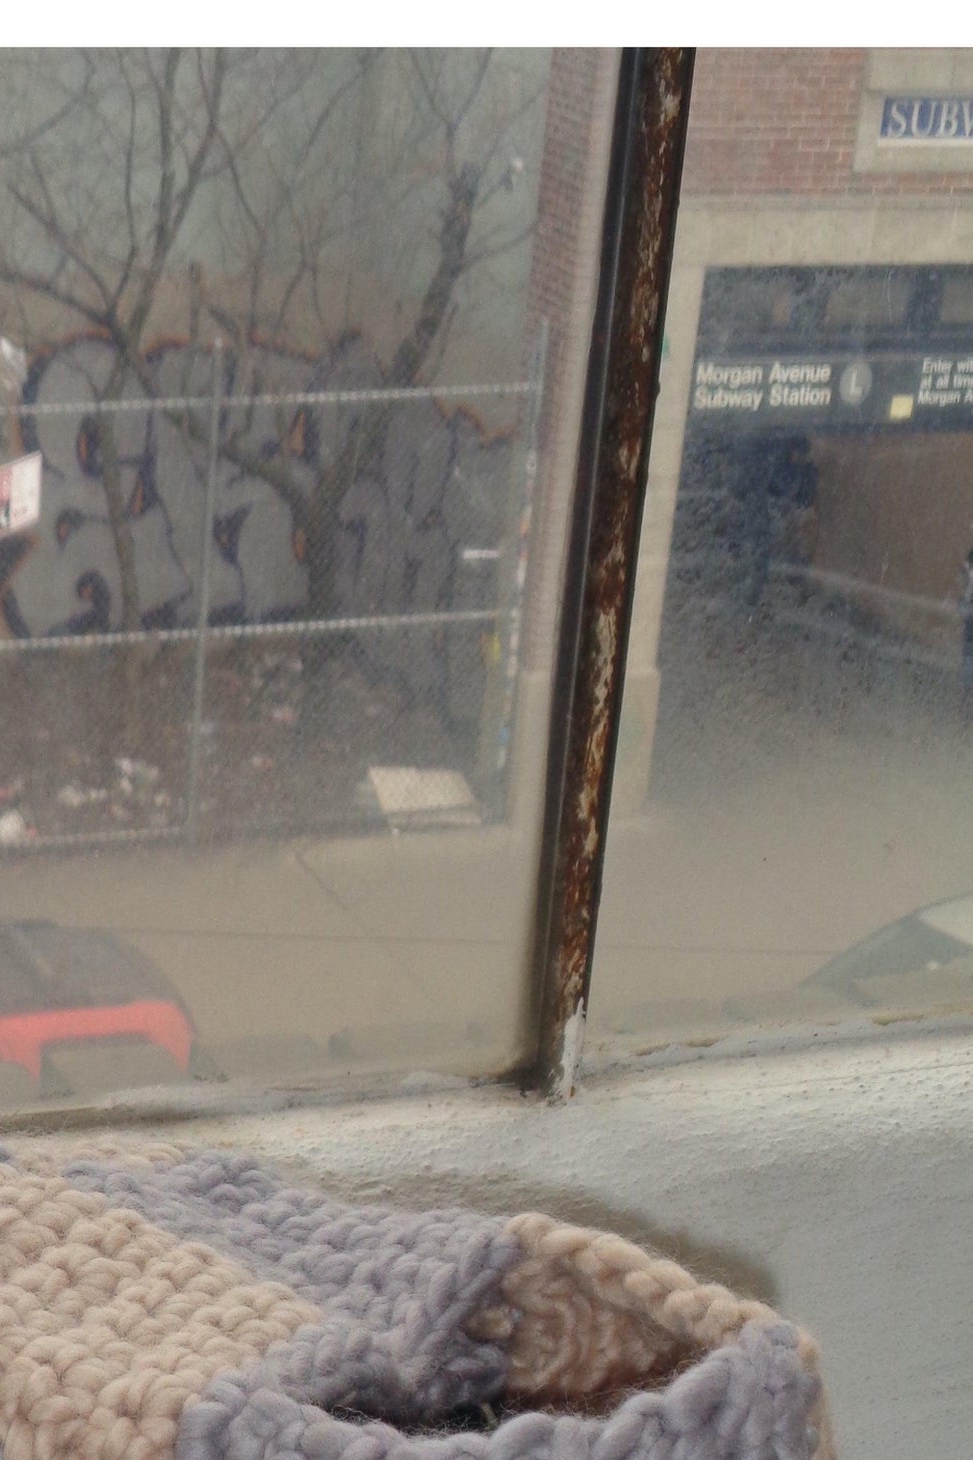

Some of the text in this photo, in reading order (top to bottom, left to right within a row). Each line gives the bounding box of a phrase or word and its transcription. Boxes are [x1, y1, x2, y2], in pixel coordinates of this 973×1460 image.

[696, 361, 831, 388] Morgan Avenue
[922, 357, 953, 373] Enter
[850, 370, 863, 395] L
[936, 375, 949, 389] all
[694, 383, 831, 410] Subway Station
[918, 390, 960, 406] Morgan
